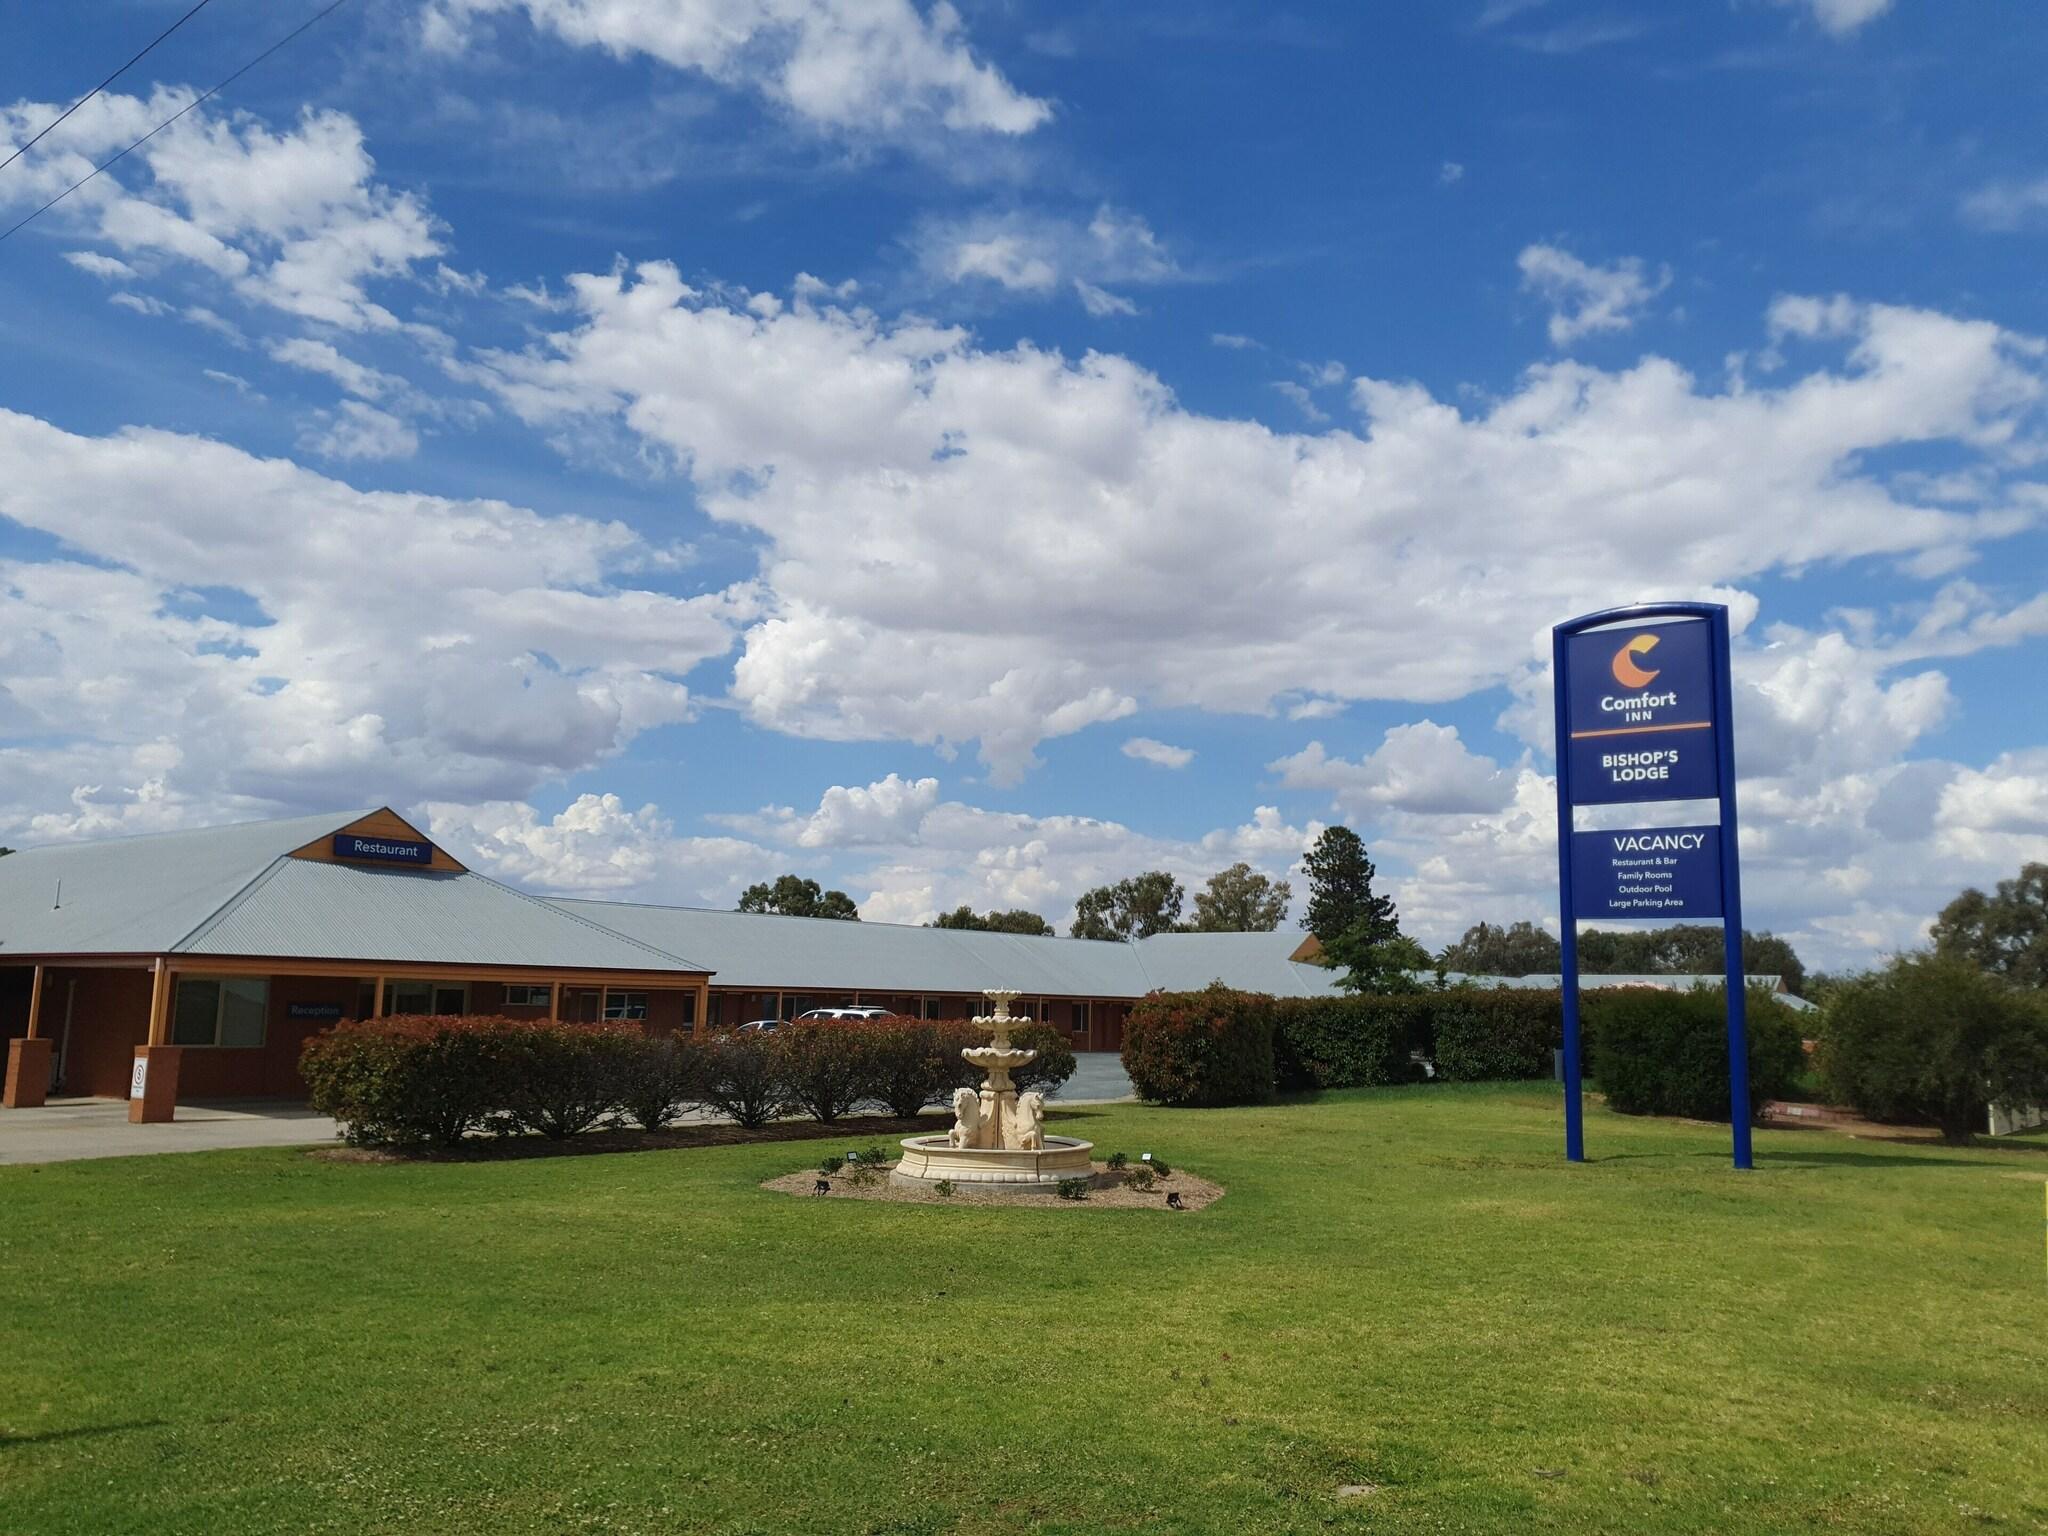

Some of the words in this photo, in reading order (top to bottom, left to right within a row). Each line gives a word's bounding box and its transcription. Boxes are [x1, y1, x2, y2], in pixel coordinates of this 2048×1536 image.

[1601, 692, 1677, 711] Comfort
[1625, 711, 1652, 722] INN
[1602, 750, 1679, 767] BISHOP'S
[1613, 766, 1669, 782] LODGE
[354, 840, 418, 857] Restaurant
[1614, 834, 1704, 851] VACANCY
[1612, 858, 1654, 866] Restaurant
[1655, 857, 1662, 865] &
[1663, 857, 1678, 865] Bar
[1618, 872, 1643, 880] Family
[1644, 871, 1673, 879] Rooms
[1618, 885, 1653, 893] Outdoor
[1654, 884, 1673, 892] Pool
[1609, 899, 1631, 908] Large
[1632, 899, 1663, 907] Parking
[1664, 898, 1683, 906] Area
[291, 1004, 340, 1016] Reception
